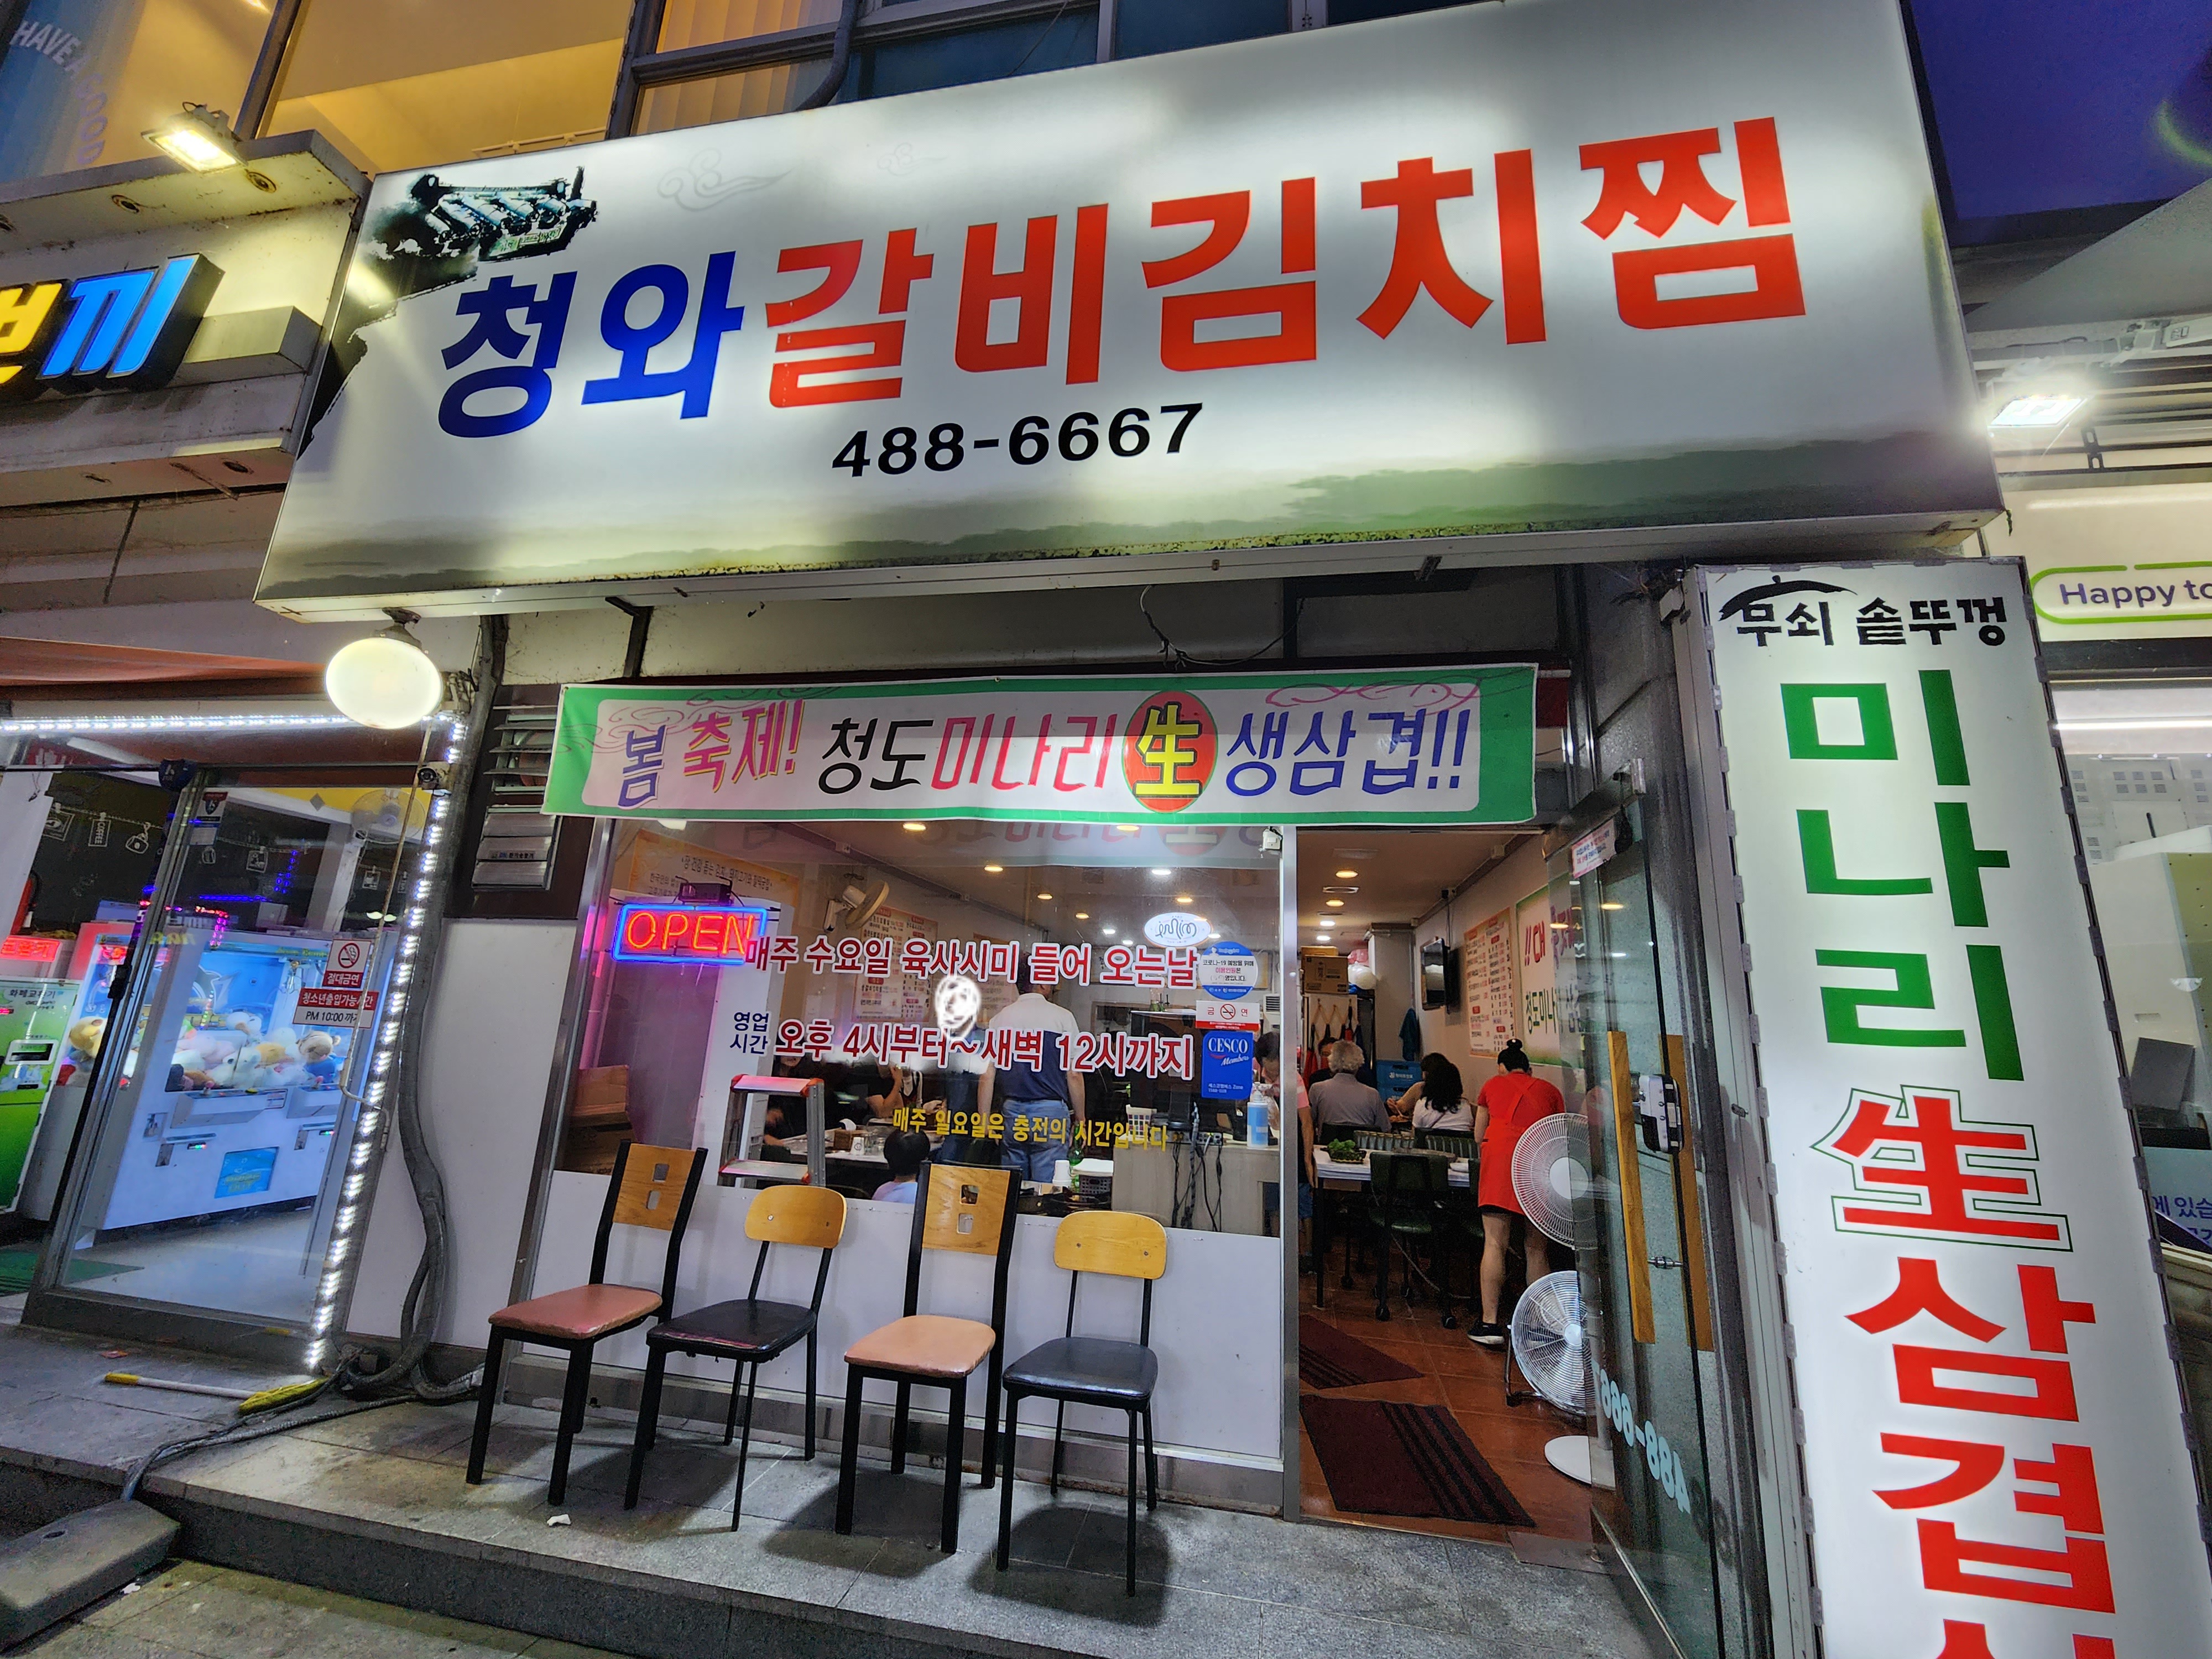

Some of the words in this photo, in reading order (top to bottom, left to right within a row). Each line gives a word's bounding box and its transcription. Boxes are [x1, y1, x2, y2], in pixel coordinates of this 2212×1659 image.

[9, 20, 82, 65] HAVE
[75, 73, 108, 165] GOOD
[831, 402, 1204, 479] 488-6667
[2059, 582, 2175, 608] Happy
[1737, 602, 1834, 646] 무쇠
[1856, 597, 2007, 646] 솥뚜껑
[618, 723, 666, 809] 봄
[682, 698, 806, 795] 축제!
[1227, 708, 1471, 796] 생삼겹!!
[95, 822, 106, 844] COFFEE
[627, 912, 754, 954] OPEN
[747, 938, 797, 972] 매주
[807, 938, 891, 975] 수요일
[902, 940, 1019, 983] 육사시미
[1030, 945, 1092, 985] 들어
[1100, 945, 1199, 989] 오는날
[327, 973, 359, 985] 절대금연
[305, 1011, 319, 1020] PM
[321, 1011, 343, 1022] 10:00
[733, 1012, 769, 1031] 영업
[1207, 1007, 1214, 1015] 금
[1241, 1008, 1248, 1017] 연
[730, 1034, 768, 1055] 시간
[775, 1020, 832, 1060] 오후
[1056, 1032, 1193, 1080] 12시까지
[1208, 1037, 1248, 1053] CESCO
[1220, 1053, 1249, 1066] Members
[893, 1108, 927, 1134] 매주
[936, 1110, 1004, 1140] 일요일은
[1012, 1115, 1067, 1144] 충전의
[1075, 1120, 1168, 1151] 시간입니다
